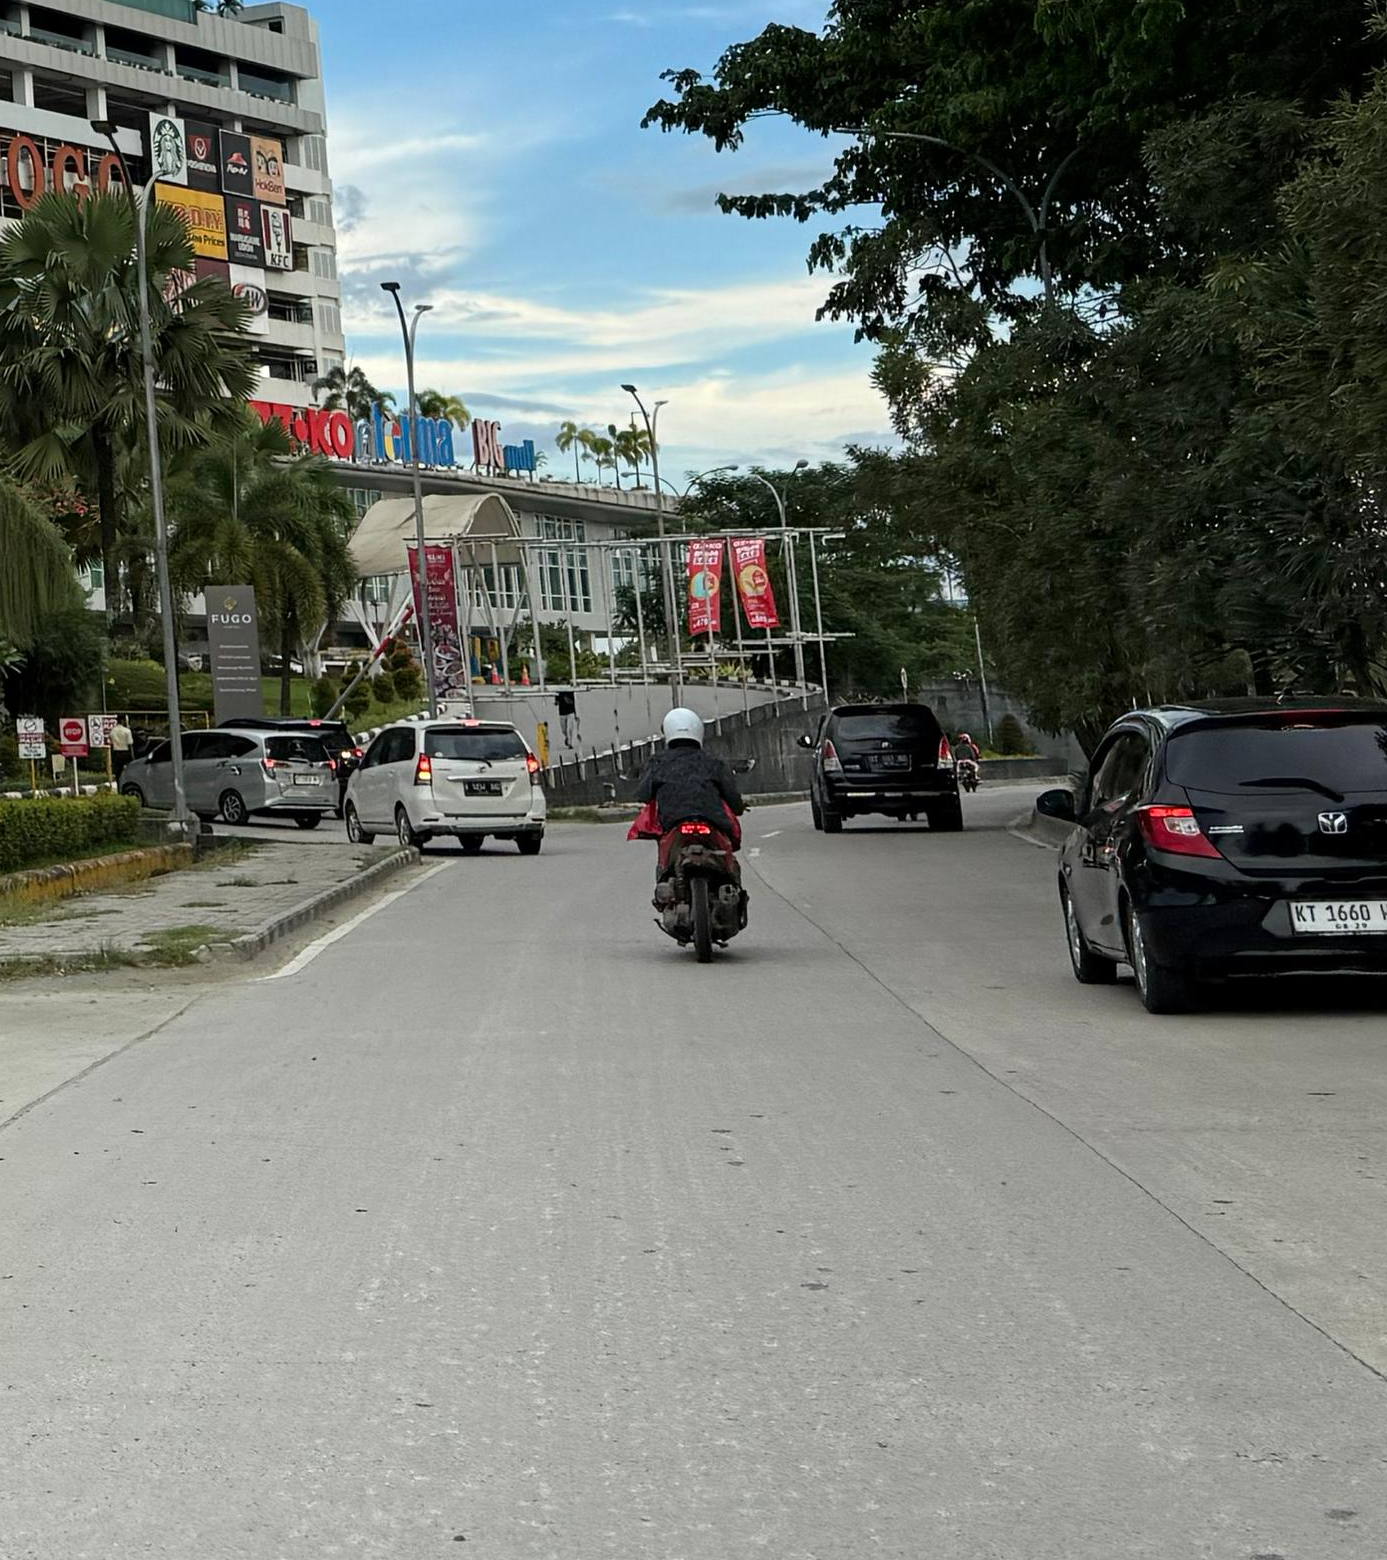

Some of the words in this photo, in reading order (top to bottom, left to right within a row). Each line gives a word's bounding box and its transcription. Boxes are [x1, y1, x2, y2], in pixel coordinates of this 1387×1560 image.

[255, 178, 283, 194] HokBen
[271, 253, 289, 268] KFC
[211, 614, 252, 624] FUGO
[1295, 905, 1315, 922] KT
[1325, 904, 1371, 922] 1660
